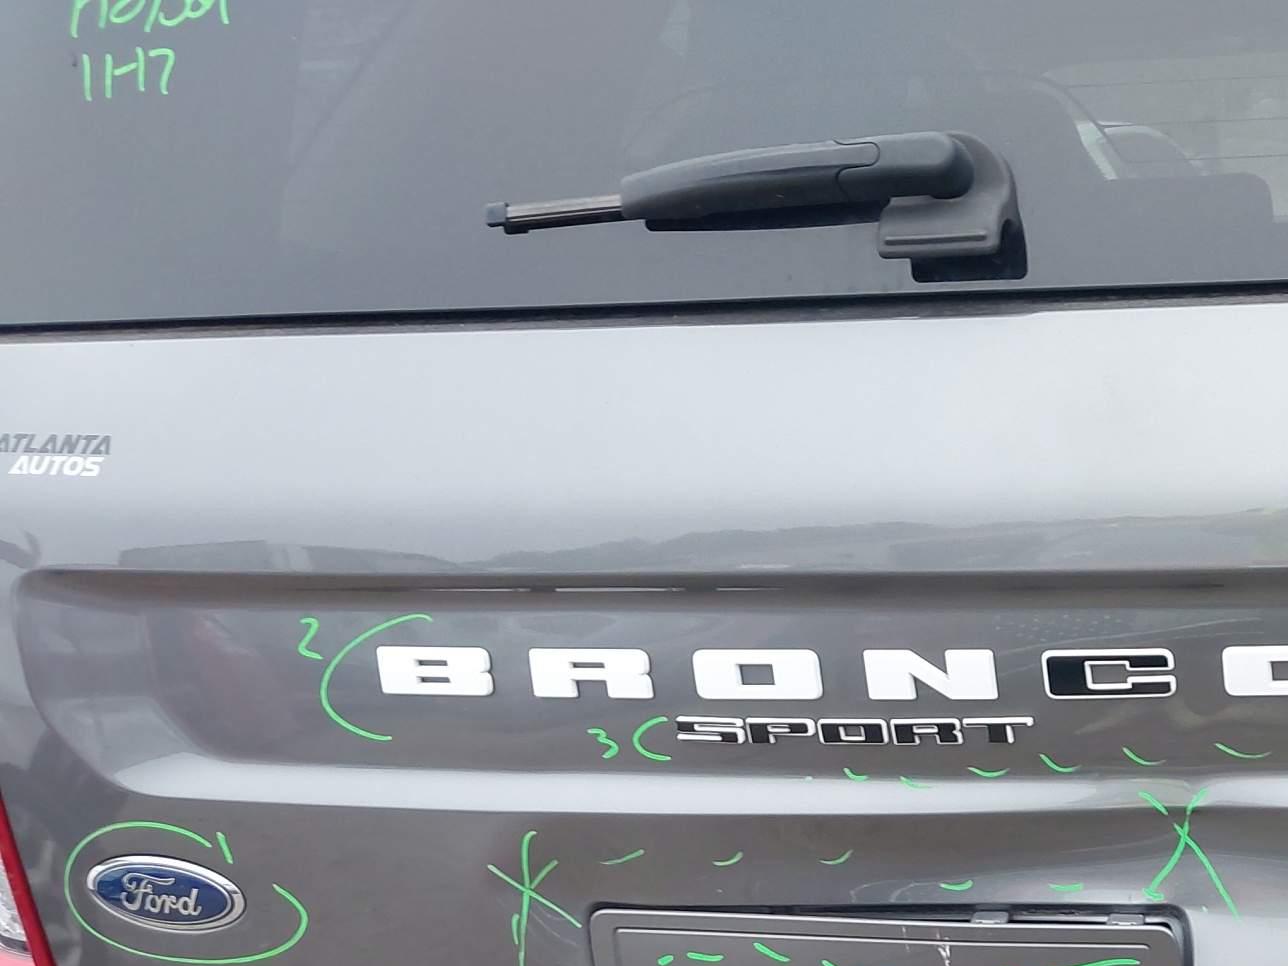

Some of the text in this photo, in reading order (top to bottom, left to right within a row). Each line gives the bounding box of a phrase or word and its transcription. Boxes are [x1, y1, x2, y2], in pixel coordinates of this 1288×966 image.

[0, 433, 112, 455] ATLANTA
[8, 455, 105, 477] AUTOS
[675, 715, 1035, 746] SPORT
[119, 871, 203, 918] Ford
